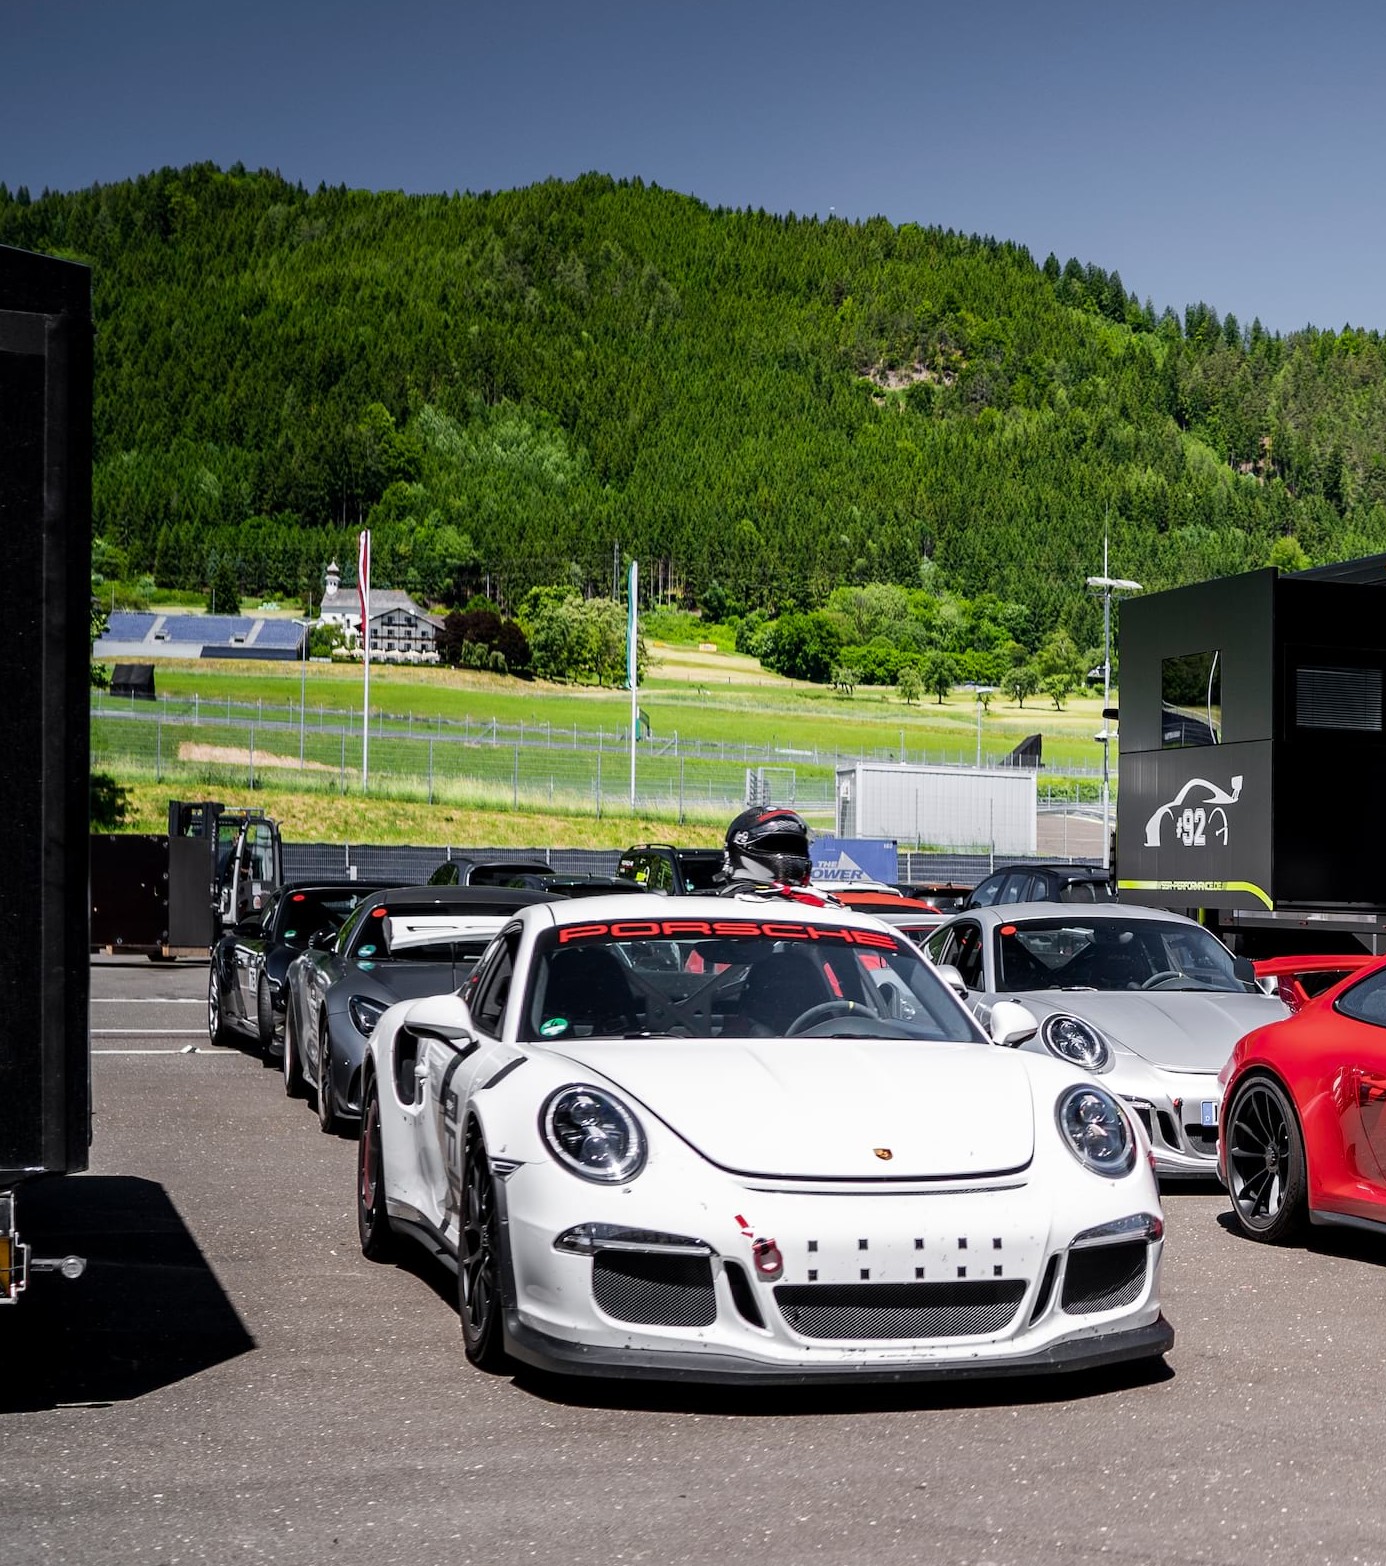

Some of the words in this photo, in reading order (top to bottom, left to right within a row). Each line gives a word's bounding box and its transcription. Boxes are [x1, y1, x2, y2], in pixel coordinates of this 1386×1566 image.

[818, 860, 838, 868] THE
[811, 869, 863, 879] OWER
[558, 920, 899, 951] PORSCHE
